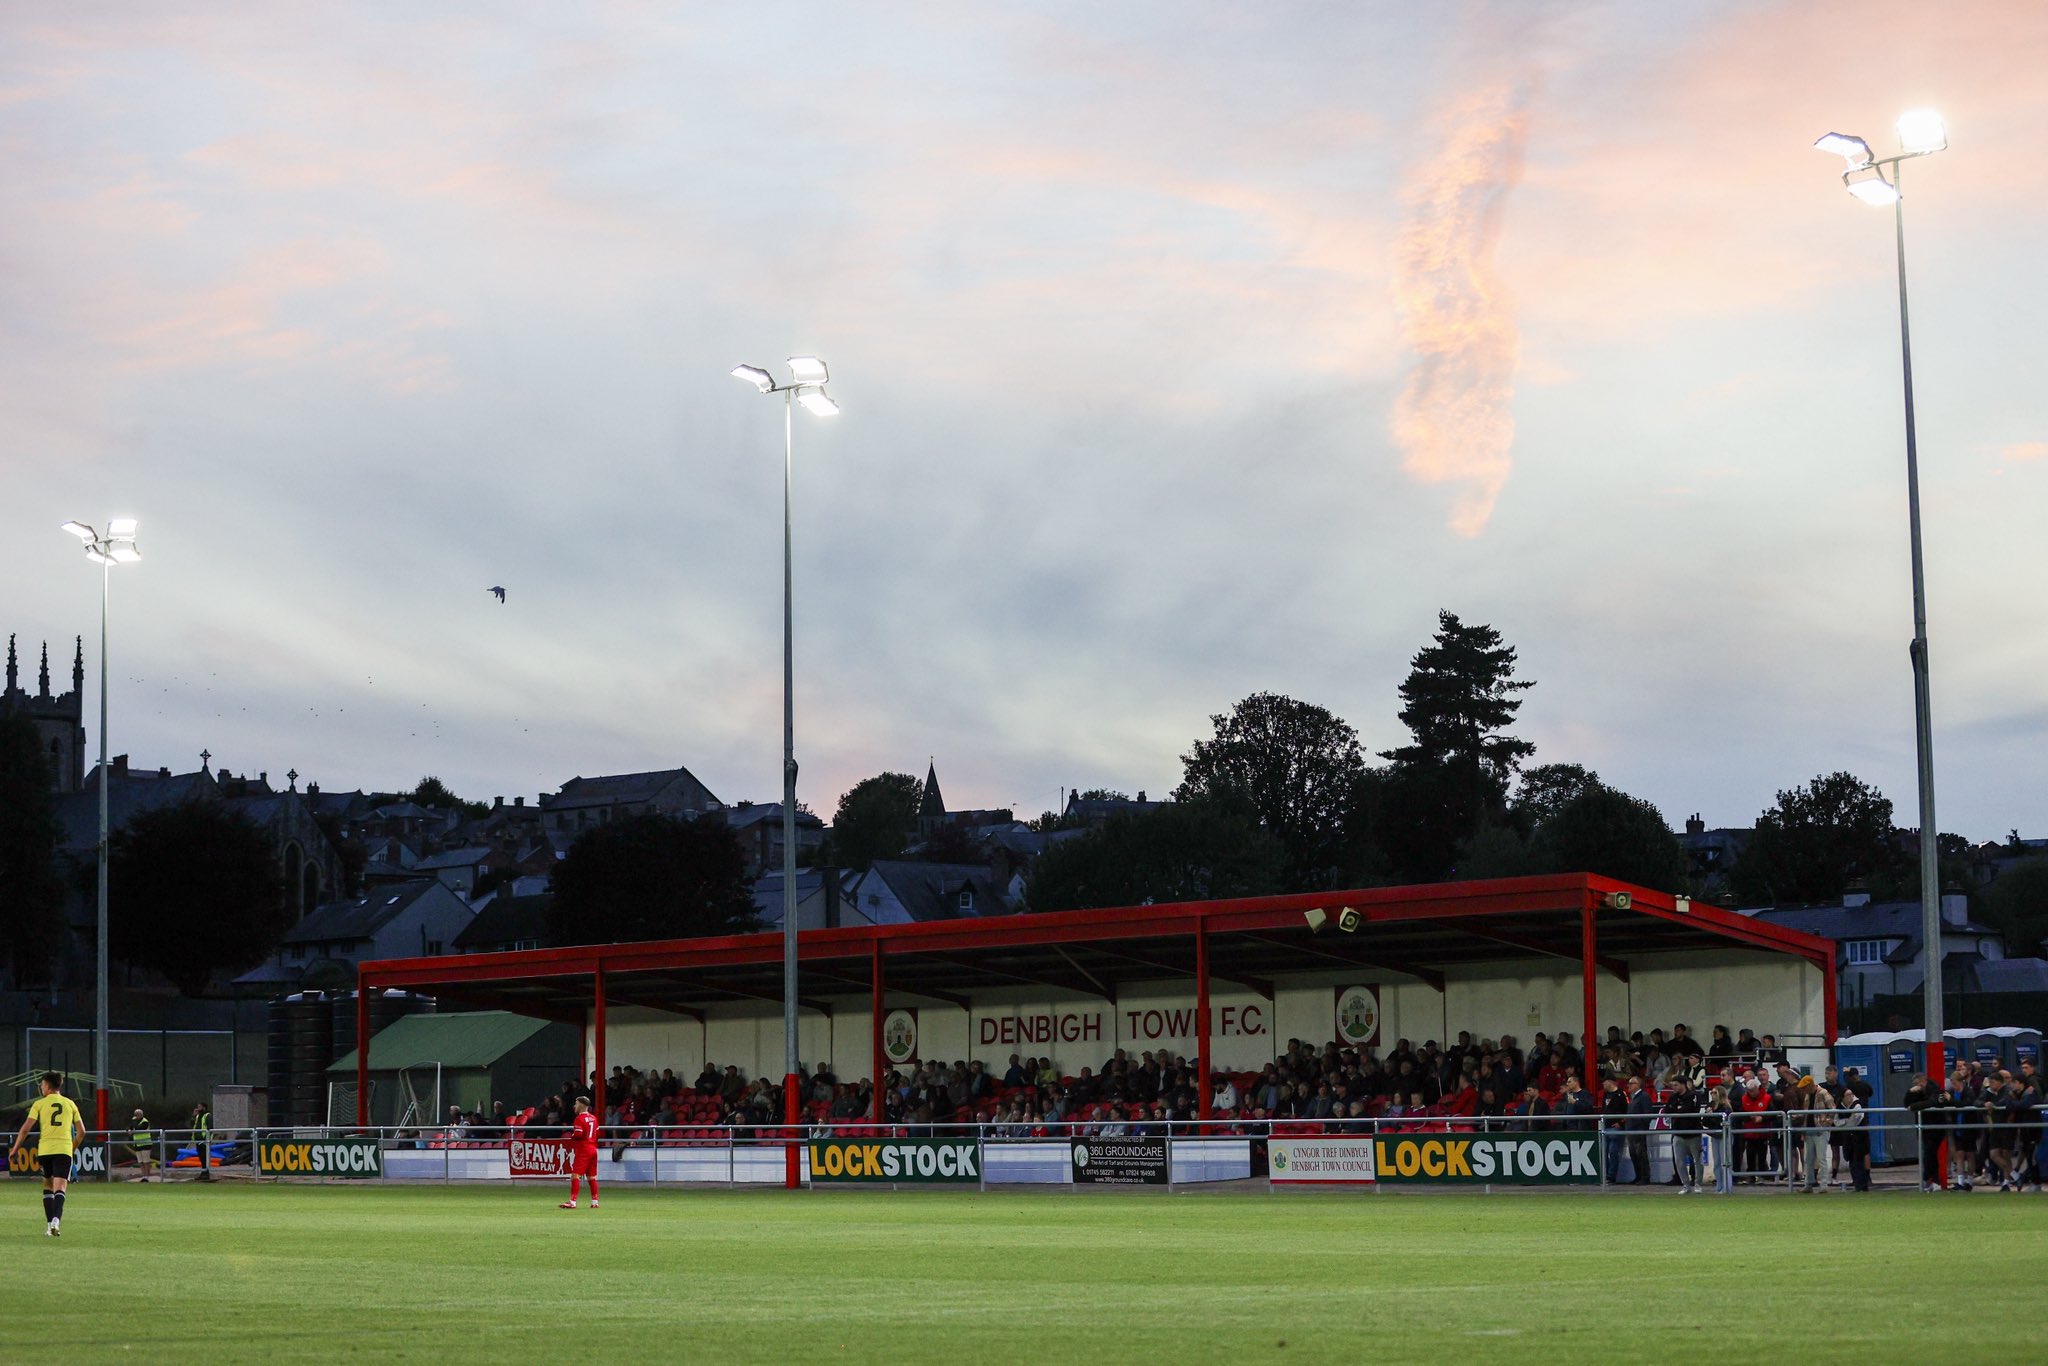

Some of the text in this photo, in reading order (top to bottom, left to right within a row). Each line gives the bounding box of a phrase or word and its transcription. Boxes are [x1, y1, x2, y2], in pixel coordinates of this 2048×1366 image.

[980, 1013, 1101, 1045] DENBIGH
[1221, 1005, 1266, 1036] F.C.
[50, 1102, 63, 1127] 2
[525, 1142, 555, 1163] FAW
[1089, 1146, 1163, 1157] 360 GROUNDCARE
[1293, 1147, 1369, 1158] CYNGOR TREF DINBYCH
[525, 1162, 555, 1172] FAIR PLAY
[1291, 1161, 1372, 1172] DENBIGH TOWN COUNCIL
